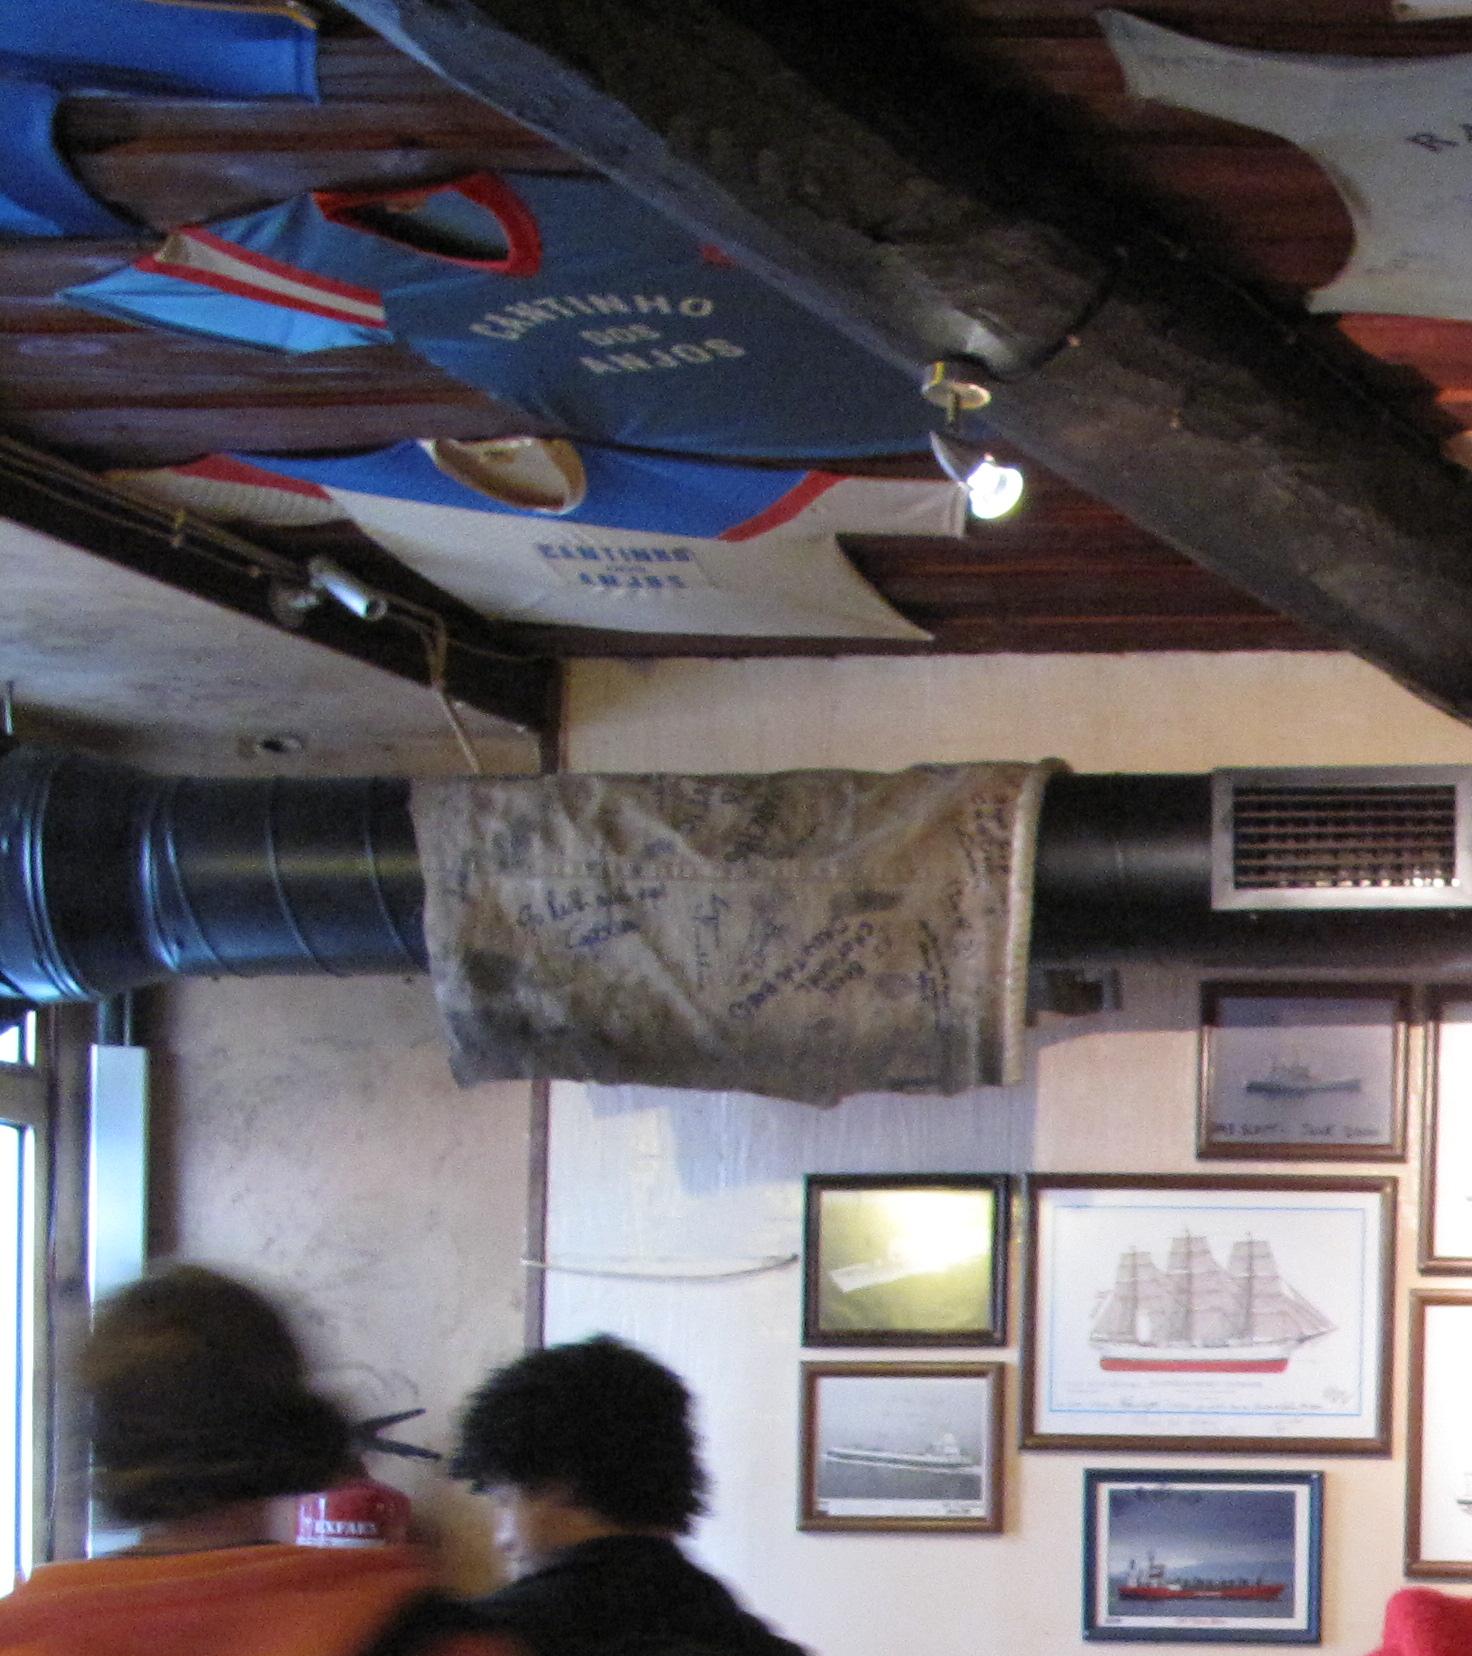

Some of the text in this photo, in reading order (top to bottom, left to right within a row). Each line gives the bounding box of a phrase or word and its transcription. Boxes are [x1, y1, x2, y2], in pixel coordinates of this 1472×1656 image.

[468, 294, 714, 341] CANTINHO
[578, 322, 661, 347] DOS
[579, 338, 745, 374] ANJOS
